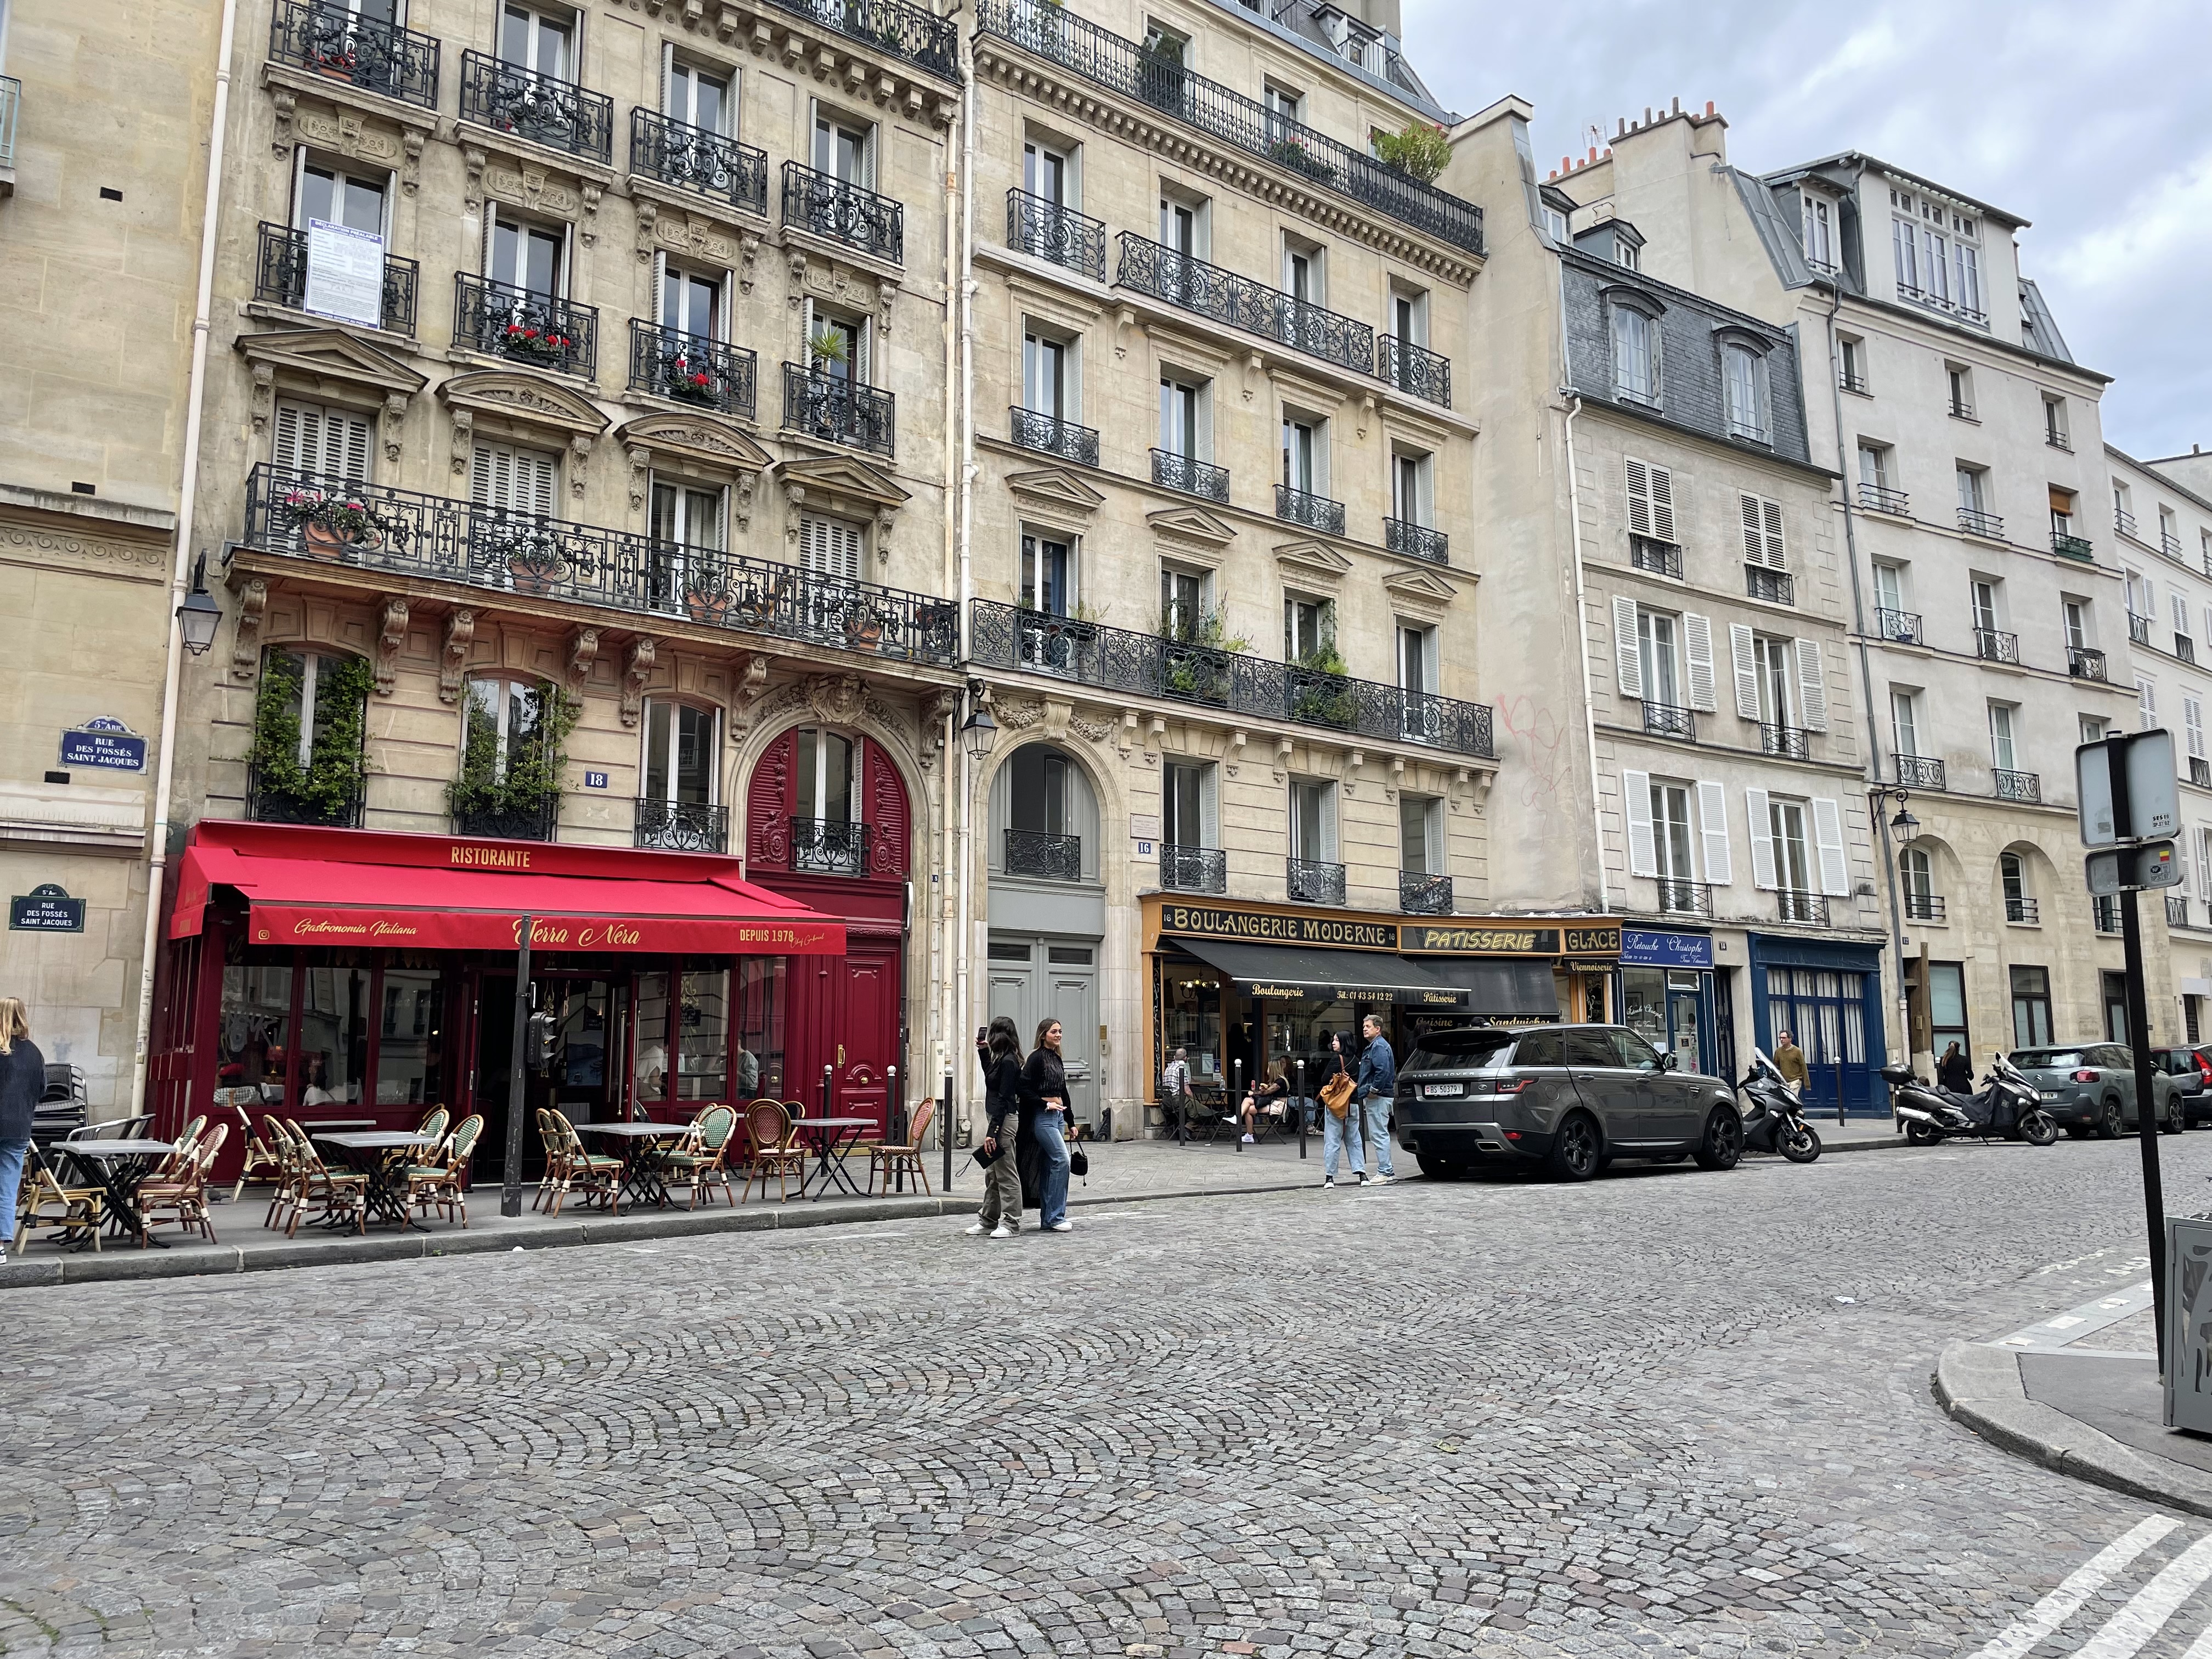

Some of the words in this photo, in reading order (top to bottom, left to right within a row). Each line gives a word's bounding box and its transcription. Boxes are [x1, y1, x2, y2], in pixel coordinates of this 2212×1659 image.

[315, 221, 349, 233] DÉCLARATION
[350, 230, 378, 241] PRÉALABLE
[76, 744, 93, 753] DES
[96, 747, 132, 757] FOSSÉS
[95, 737, 114, 747] RUE
[67, 753, 96, 762] SAINT
[98, 756, 139, 766] JACQUES
[590, 774, 603, 786] 18
[1140, 843, 1149, 853] 16
[451, 847, 531, 868] RISTORANTE
[294, 918, 367, 936] Gastronomia
[369, 920, 418, 936] Italiana
[512, 918, 569, 946] Terra
[578, 924, 641, 947] Nera
[740, 929, 769, 941] DEPUIS
[772, 930, 794, 943] 1978
[1174, 909, 1297, 938] BOULANGERIE
[1303, 920, 1385, 945] MODERNE
[1424, 929, 1536, 950] PATISSERIE
[1568, 931, 1618, 950] GLACE
[1627, 934, 1659, 951] Retouche
[1667, 936, 1703, 956] Christophe
[1570, 961, 1613, 972] Viennoiserie
[1252, 984, 1304, 999] Boulangerie
[1367, 992, 1375, 1000] 54
[1423, 991, 1457, 1003] Pâtisserie
